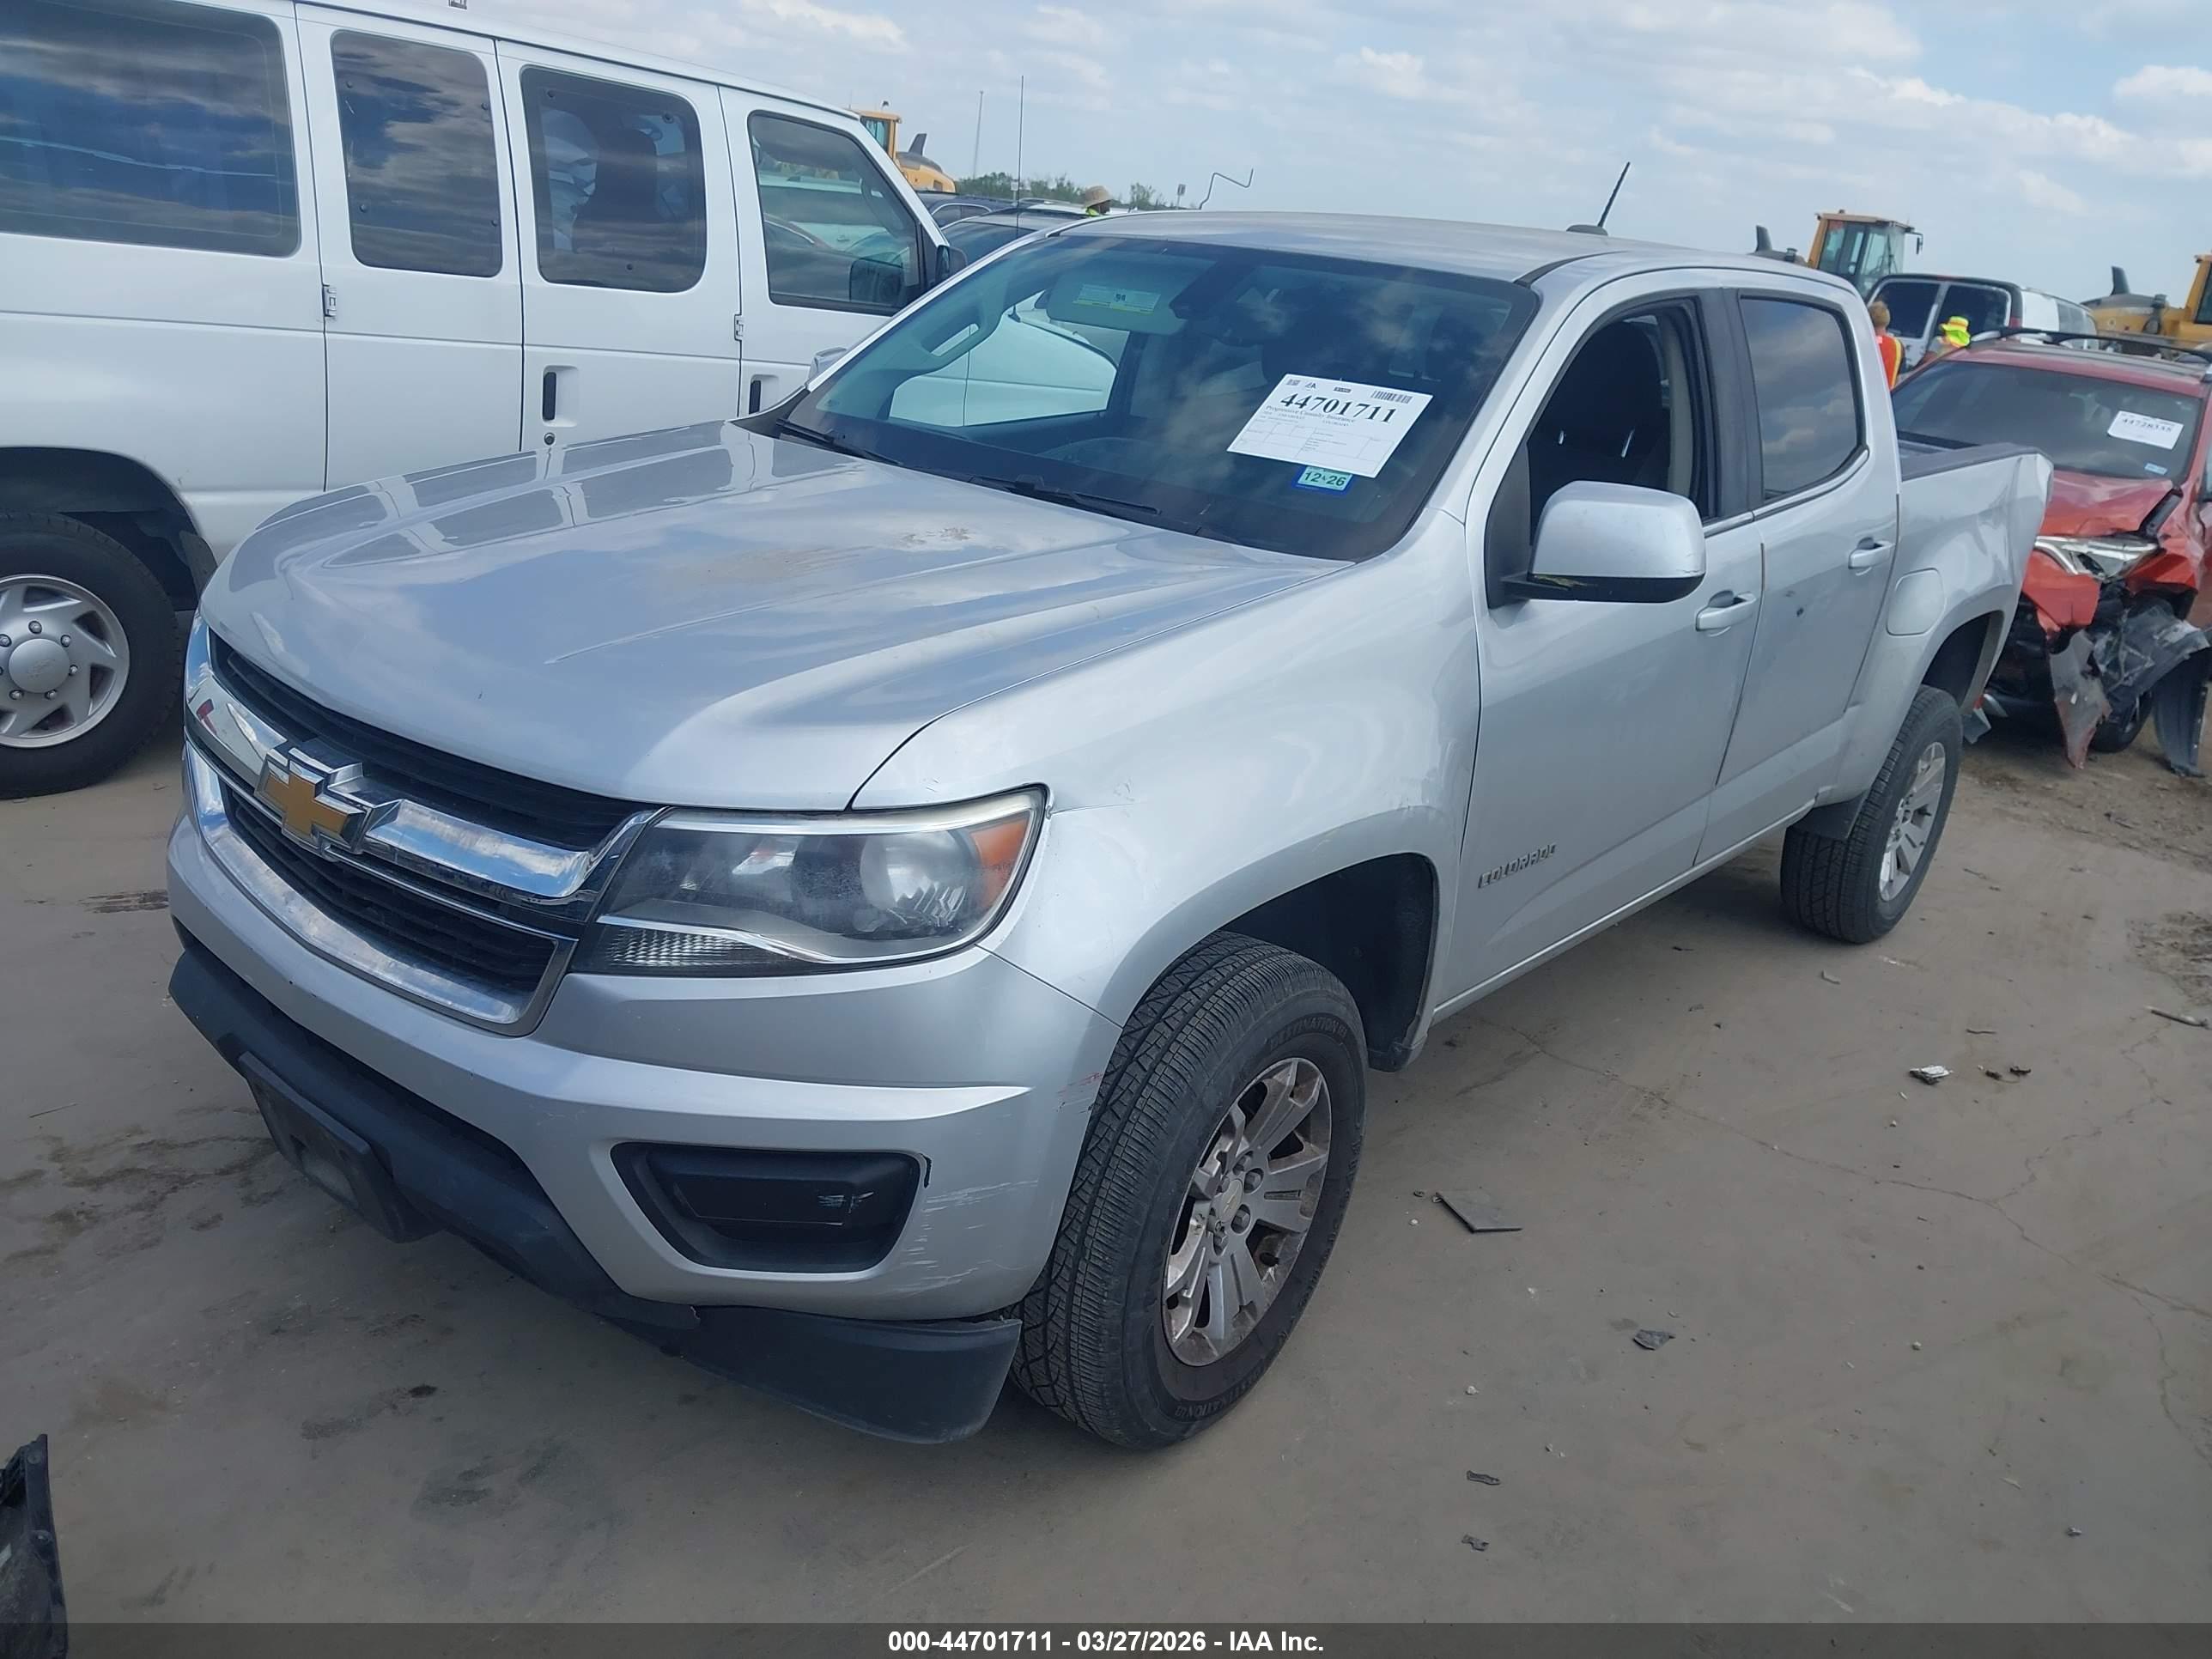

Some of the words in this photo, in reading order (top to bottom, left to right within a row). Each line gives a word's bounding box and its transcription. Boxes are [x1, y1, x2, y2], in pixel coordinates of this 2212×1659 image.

[1280, 392, 1397, 423] 44701711
[1304, 471, 1322, 483] 12
[1326, 475, 1347, 487] 26
[1478, 843, 1557, 889] COLORADO
